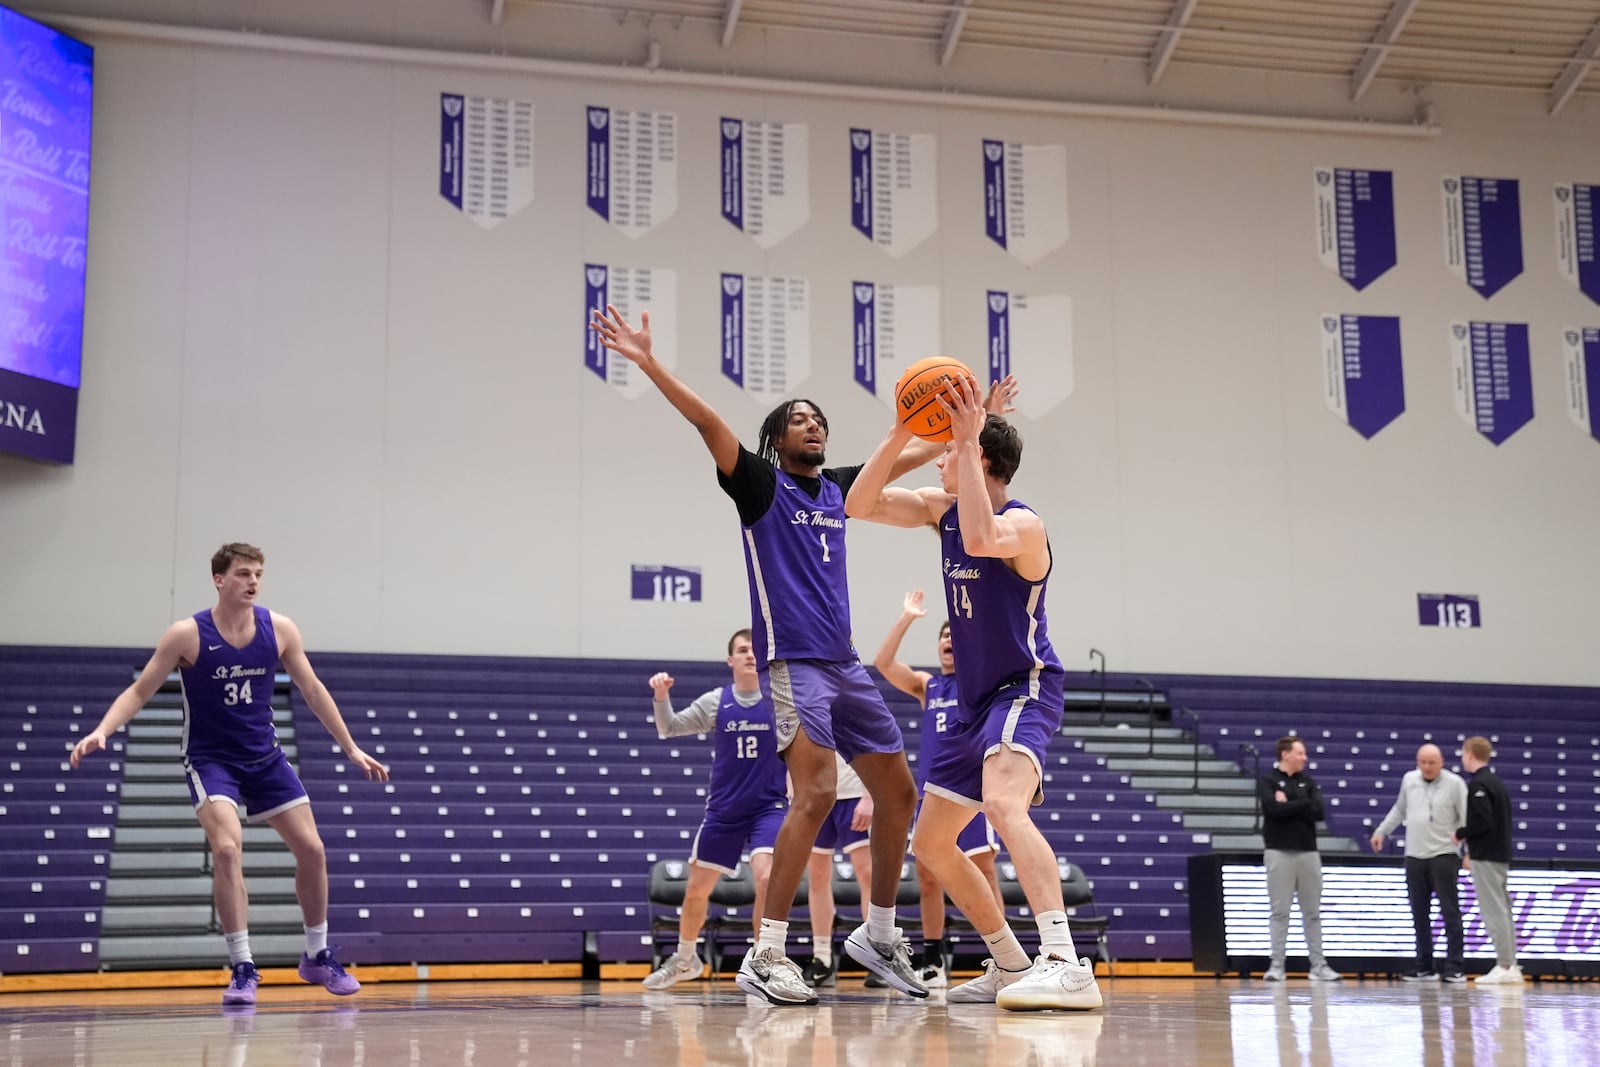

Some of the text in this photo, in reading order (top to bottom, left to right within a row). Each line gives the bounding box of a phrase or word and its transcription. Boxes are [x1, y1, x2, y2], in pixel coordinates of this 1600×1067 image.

[13, 129, 63, 172] Roll
[901, 373, 953, 410] Wilson
[810, 510, 844, 529] Thomas
[820, 533, 830, 563] 1
[653, 574, 691, 602] 112
[952, 583, 973, 619] 14
[1437, 602, 1472, 629] 113
[230, 665, 267, 679] Thomas
[224, 680, 253, 706] 34
[738, 720, 770, 732] Thomas
[935, 711, 947, 733] 2
[736, 735, 758, 759] 12
